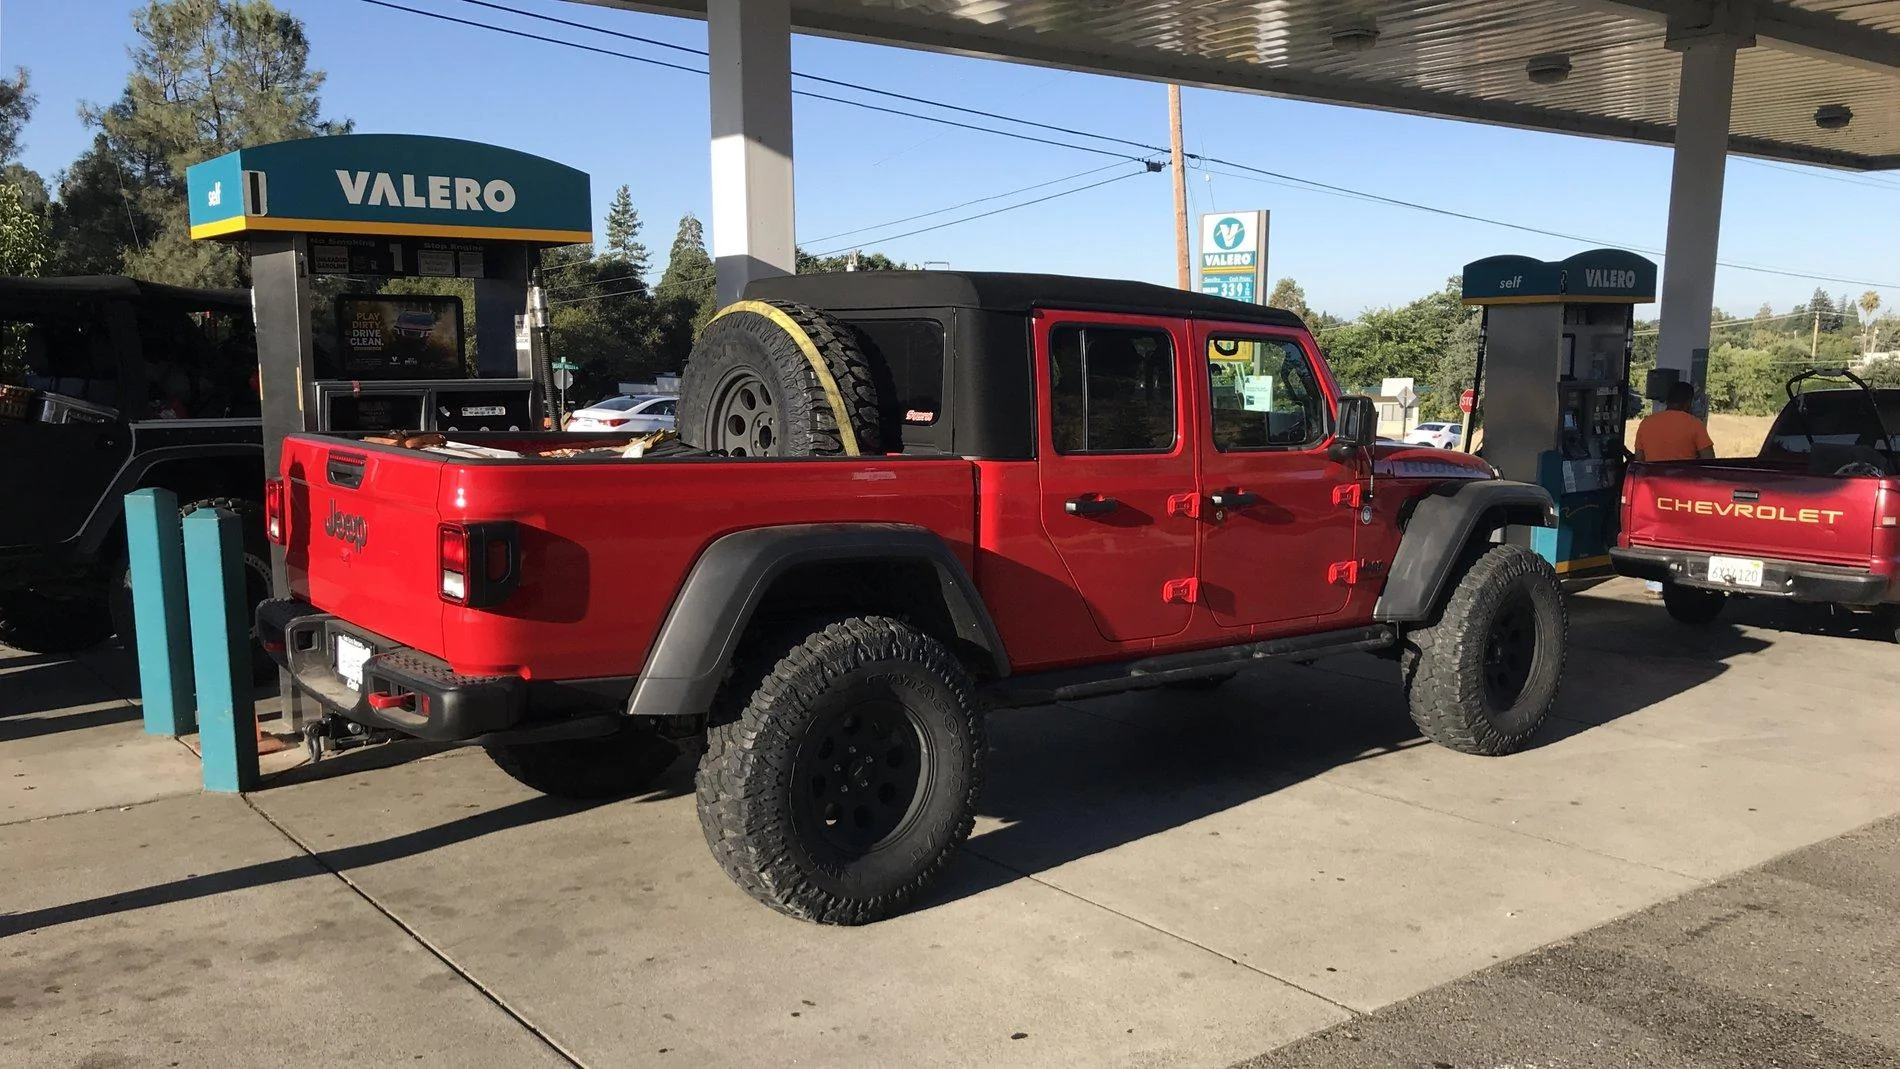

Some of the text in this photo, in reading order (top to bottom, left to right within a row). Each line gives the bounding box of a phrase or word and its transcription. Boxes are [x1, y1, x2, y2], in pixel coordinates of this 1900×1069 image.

[208, 181, 221, 207] self
[336, 169, 516, 213] VALERO
[329, 238, 376, 248] Smoking
[423, 242, 485, 252] Stop Engine
[389, 243, 403, 272] 1
[1204, 253, 1252, 266] VALERO
[1499, 276, 1522, 289] self
[1585, 268, 1636, 289] VALERO
[356, 312, 381, 321] PLAY
[352, 329, 382, 338] DRIVE
[350, 338, 384, 346] CLEAN.
[1657, 497, 1843, 525] CHEVROLET
[325, 499, 368, 554] Jeep
